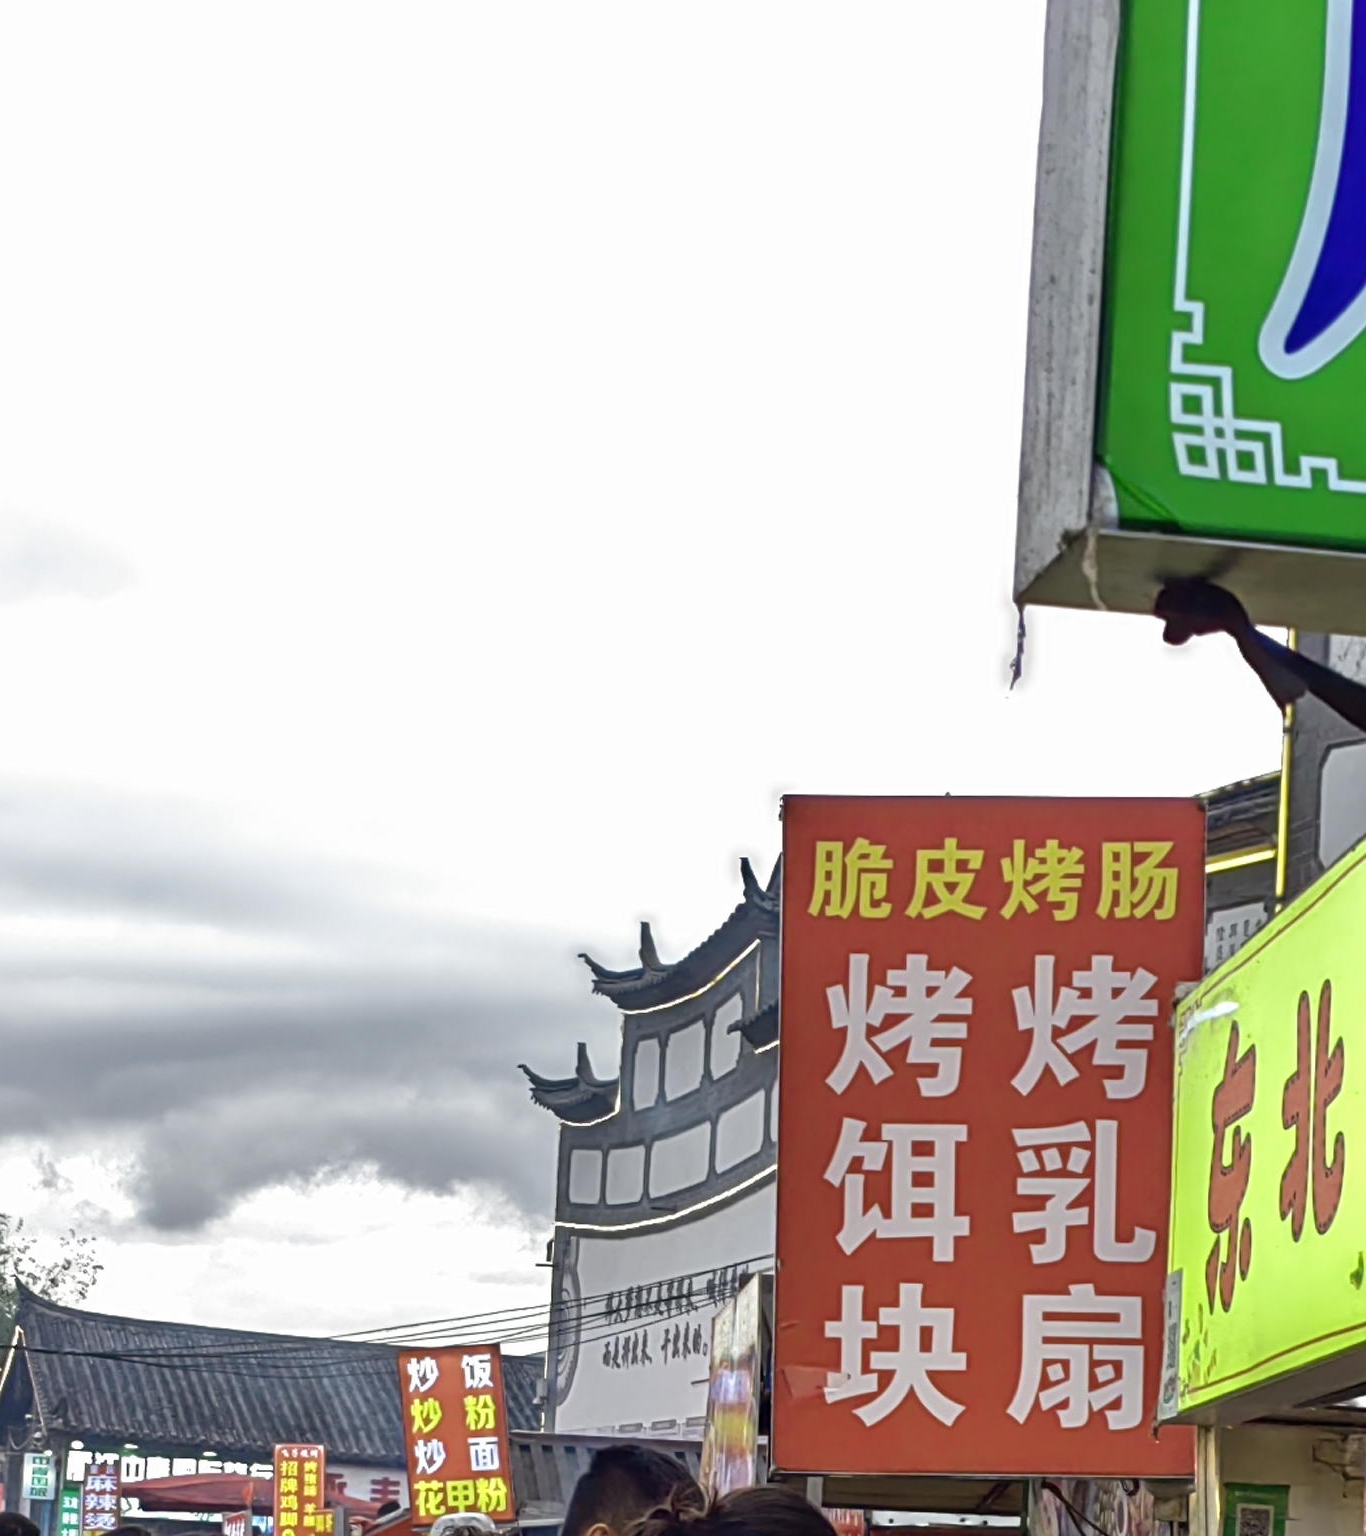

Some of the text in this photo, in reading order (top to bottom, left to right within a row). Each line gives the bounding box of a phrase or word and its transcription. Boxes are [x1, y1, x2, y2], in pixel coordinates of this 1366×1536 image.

[808, 837, 1179, 922] 脆皮烤肠
[824, 953, 974, 1428] 烤饵块
[1006, 954, 1160, 1431] 烤乳扇
[406, 1353, 494, 1393] 炒饭
[410, 1394, 496, 1434] 炒粉
[414, 1437, 500, 1475] 炒面
[413, 1477, 508, 1518] 花甲粉
